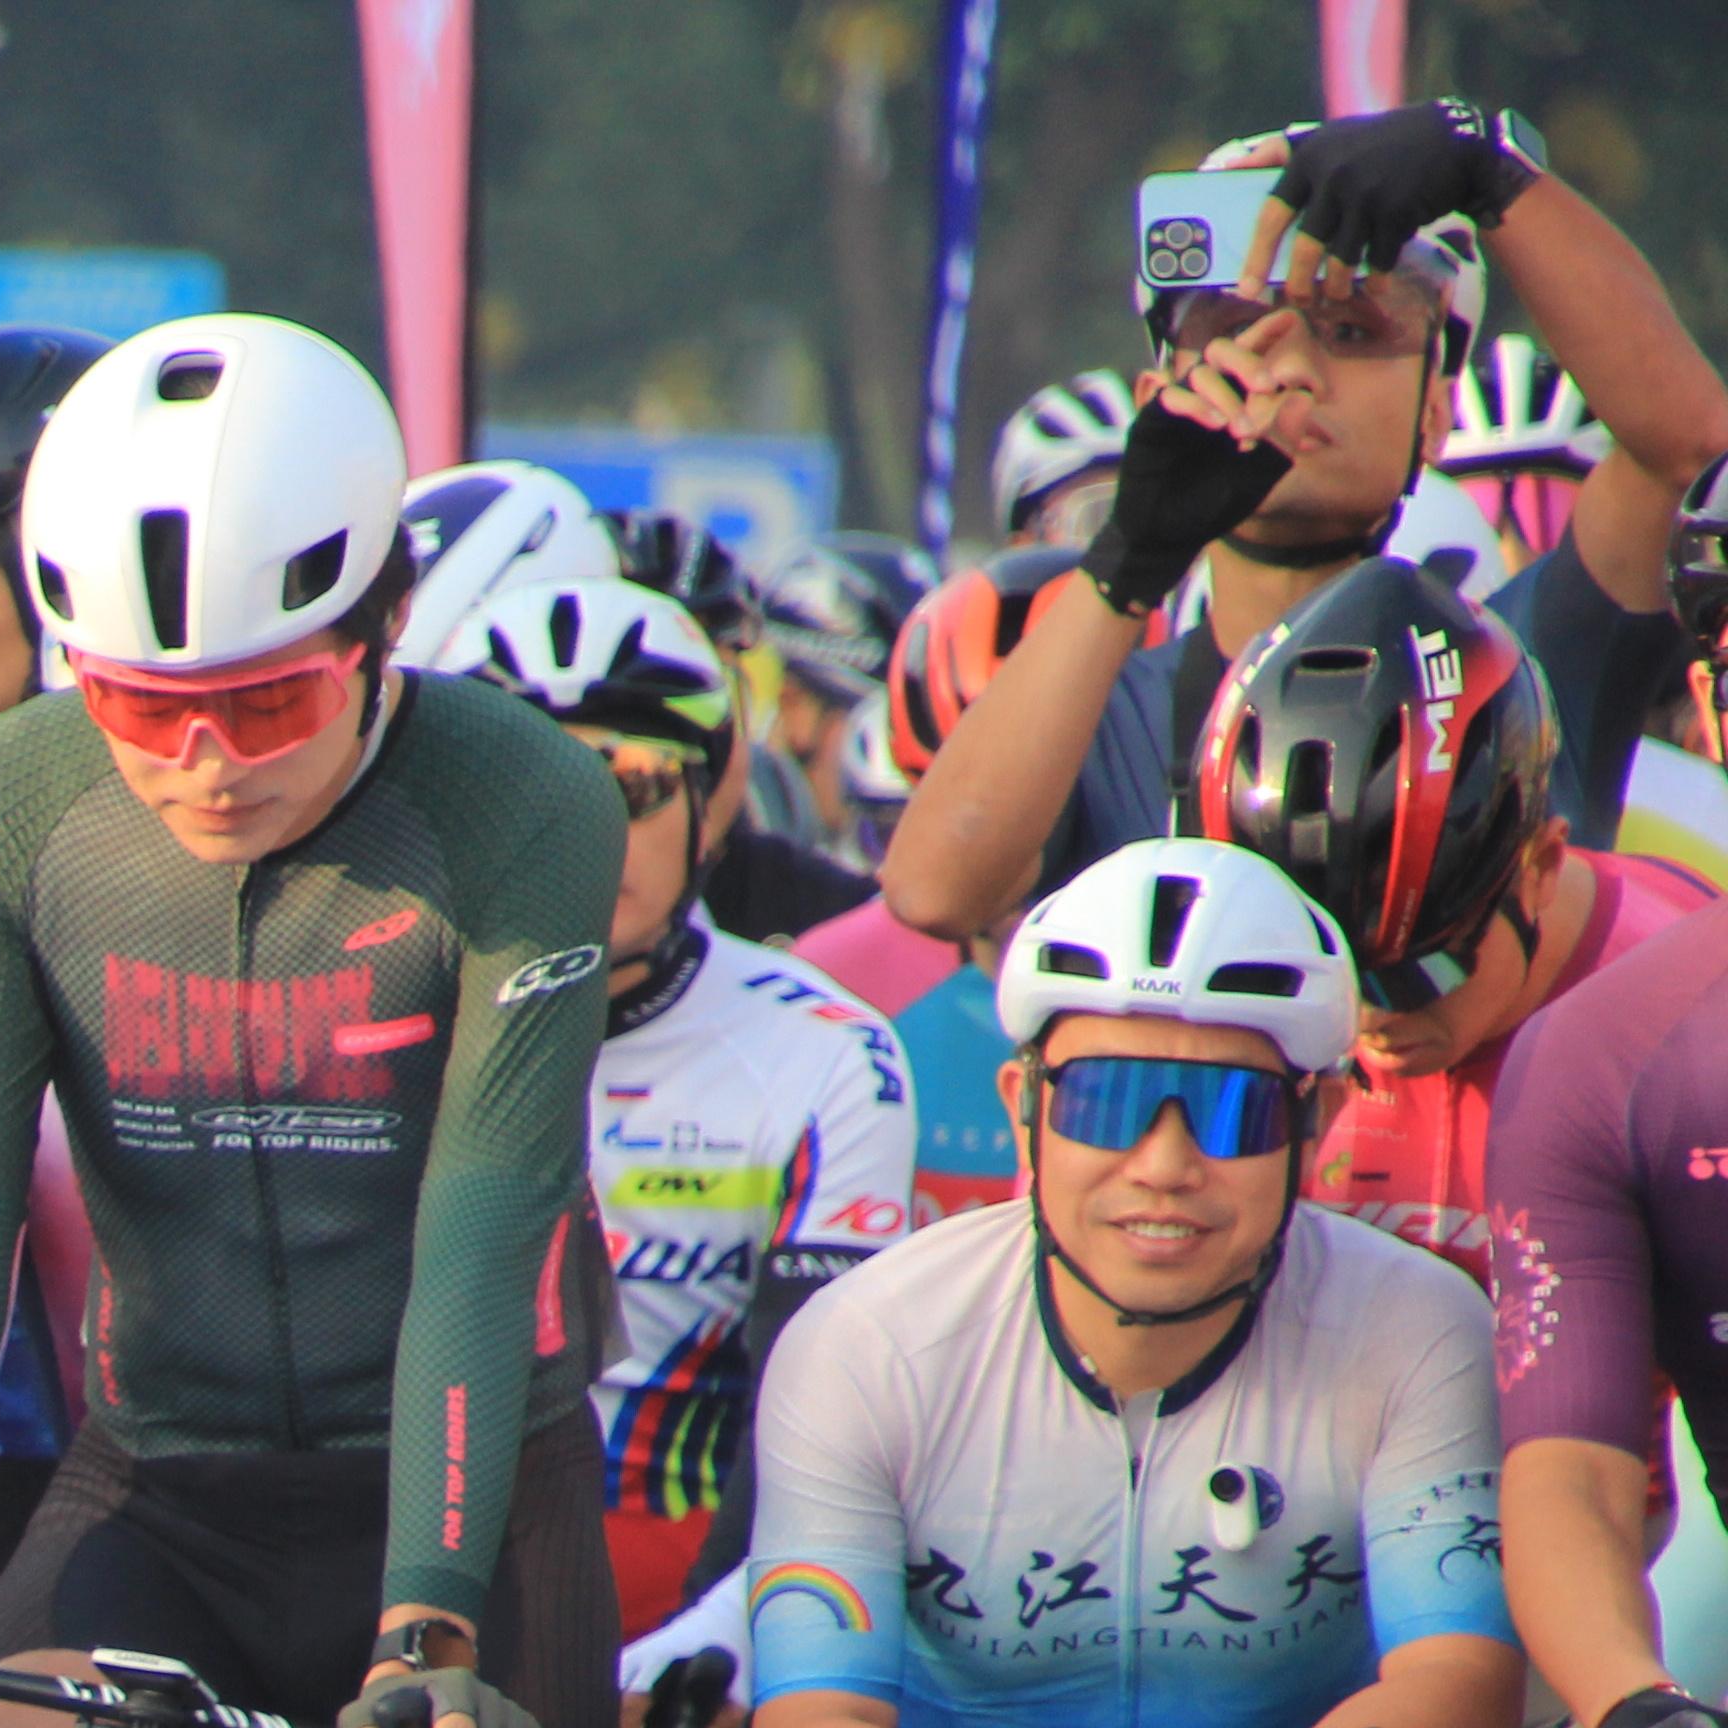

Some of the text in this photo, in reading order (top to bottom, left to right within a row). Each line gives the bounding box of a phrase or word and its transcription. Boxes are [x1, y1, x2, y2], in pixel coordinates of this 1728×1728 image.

[1409, 623, 1465, 773] MET
[1132, 978, 1182, 995] KASK
[260, 1134, 305, 1148] TOP
[905, 1534, 1366, 1627] 九江天天
